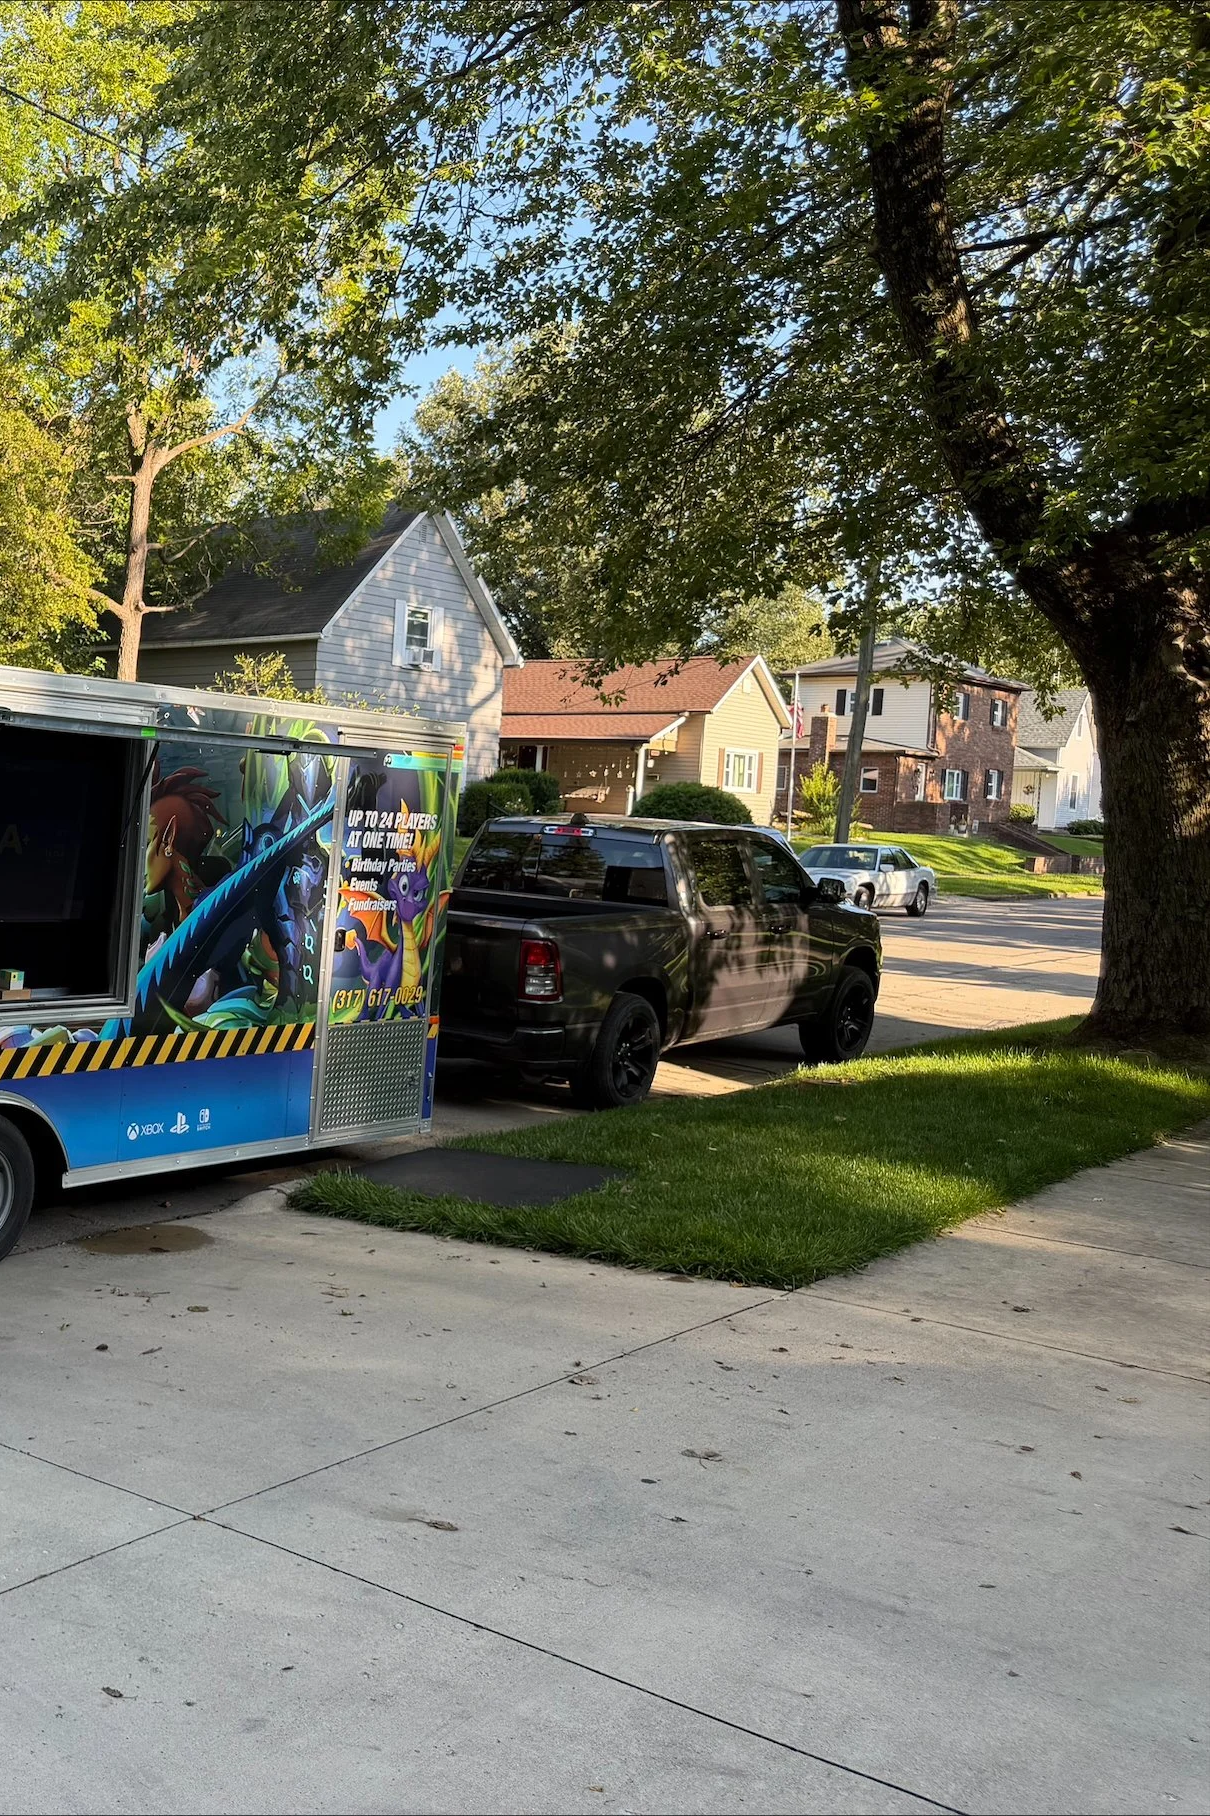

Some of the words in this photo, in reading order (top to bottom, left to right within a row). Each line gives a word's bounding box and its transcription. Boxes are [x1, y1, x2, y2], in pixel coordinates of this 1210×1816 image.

[347, 809, 363, 828] UP
[364, 810, 378, 828] TO
[378, 811, 394, 829] 24
[394, 811, 438, 830] PLAYERS
[346, 830, 362, 848] AT
[362, 830, 384, 849] ONE
[385, 832, 414, 850] TIME!
[351, 858, 387, 875] Birthday
[388, 858, 417, 873] Parties
[350, 877, 378, 892] Events
[347, 897, 397, 911] Fundraisers
[332, 988, 366, 1014] (317)
[368, 985, 424, 1007] 617-0029
[140, 1122, 165, 1136] XBOX
